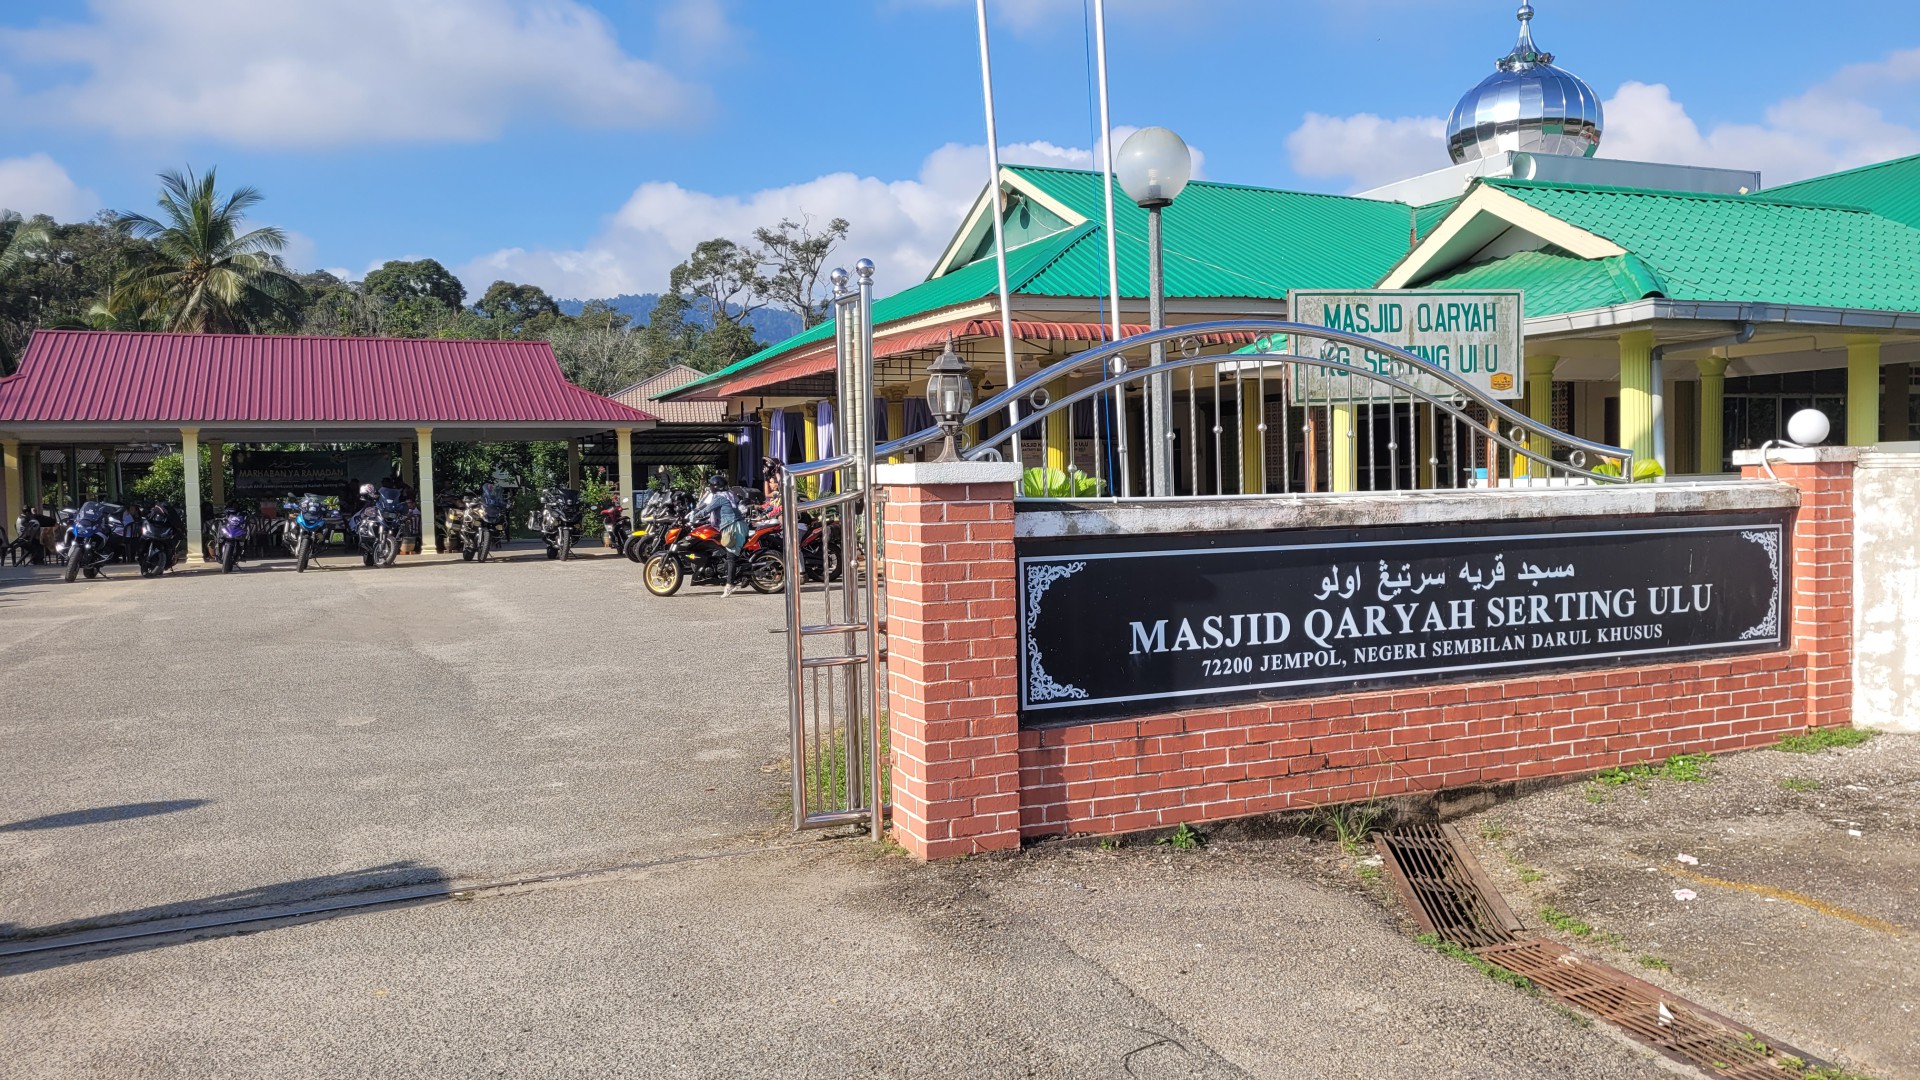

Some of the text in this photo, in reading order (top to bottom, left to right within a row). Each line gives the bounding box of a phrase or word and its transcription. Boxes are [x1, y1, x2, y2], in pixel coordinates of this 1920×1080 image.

[1324, 302, 1497, 333] MASJID QARYAH
[239, 468, 344, 478] MARHABAN YA RAMADAN
[1314, 564, 1361, 600] اولو
[1517, 561, 1575, 587] مسجد
[1128, 583, 1714, 655] MASJID QARYAH SERTING ULU
[1202, 623, 1663, 677] 72200 JEMPOL, NEGERI SEMBILAN DARUL KHUSUS
